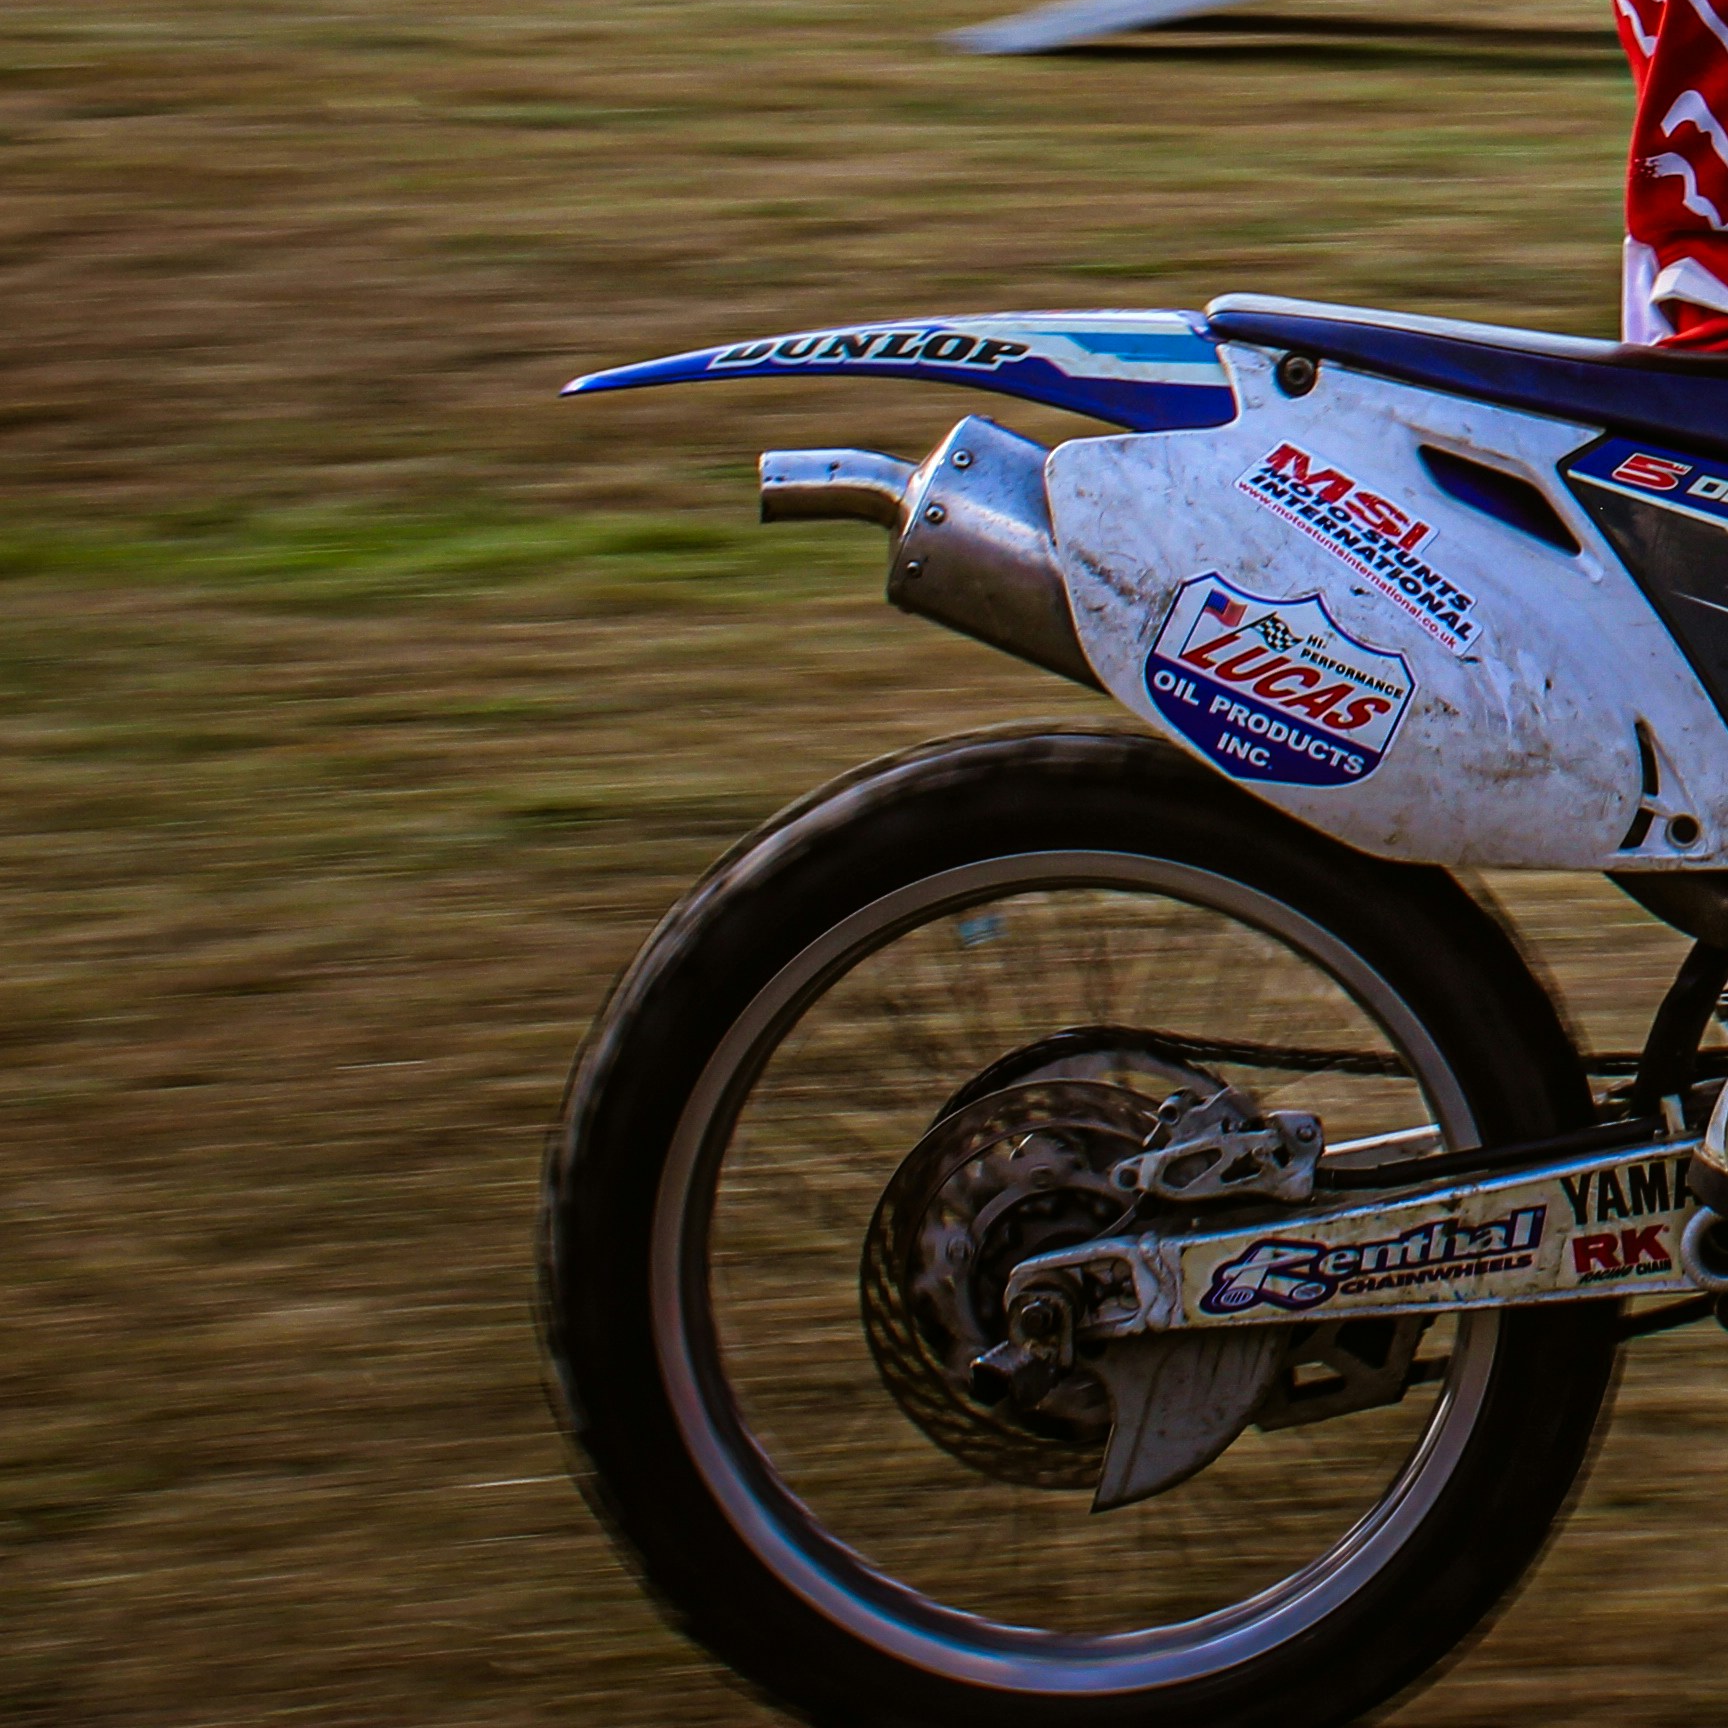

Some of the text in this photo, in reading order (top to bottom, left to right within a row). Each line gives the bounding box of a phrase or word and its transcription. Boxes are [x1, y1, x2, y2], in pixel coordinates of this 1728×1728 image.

[715, 331, 1031, 365] DUNLOP
[1260, 467, 1475, 612] MOTO-STUNTS
[1266, 442, 1431, 552] MSI
[1238, 482, 1457, 650] www.motostuntsinternational.co.uk
[1250, 474, 1474, 641] INTERNATIONAL
[1152, 669, 1366, 775] OIL PRODUCTS
[1179, 633, 1392, 730] LUCAS
[1300, 648, 1405, 700] PERFORMANCE
[1206, 1207, 1541, 1310] Renthal
[1339, 1253, 1534, 1295] CHAINWHEELS
[1572, 1223, 1672, 1274] RK
[1635, 1257, 1673, 1276] CHAIN
